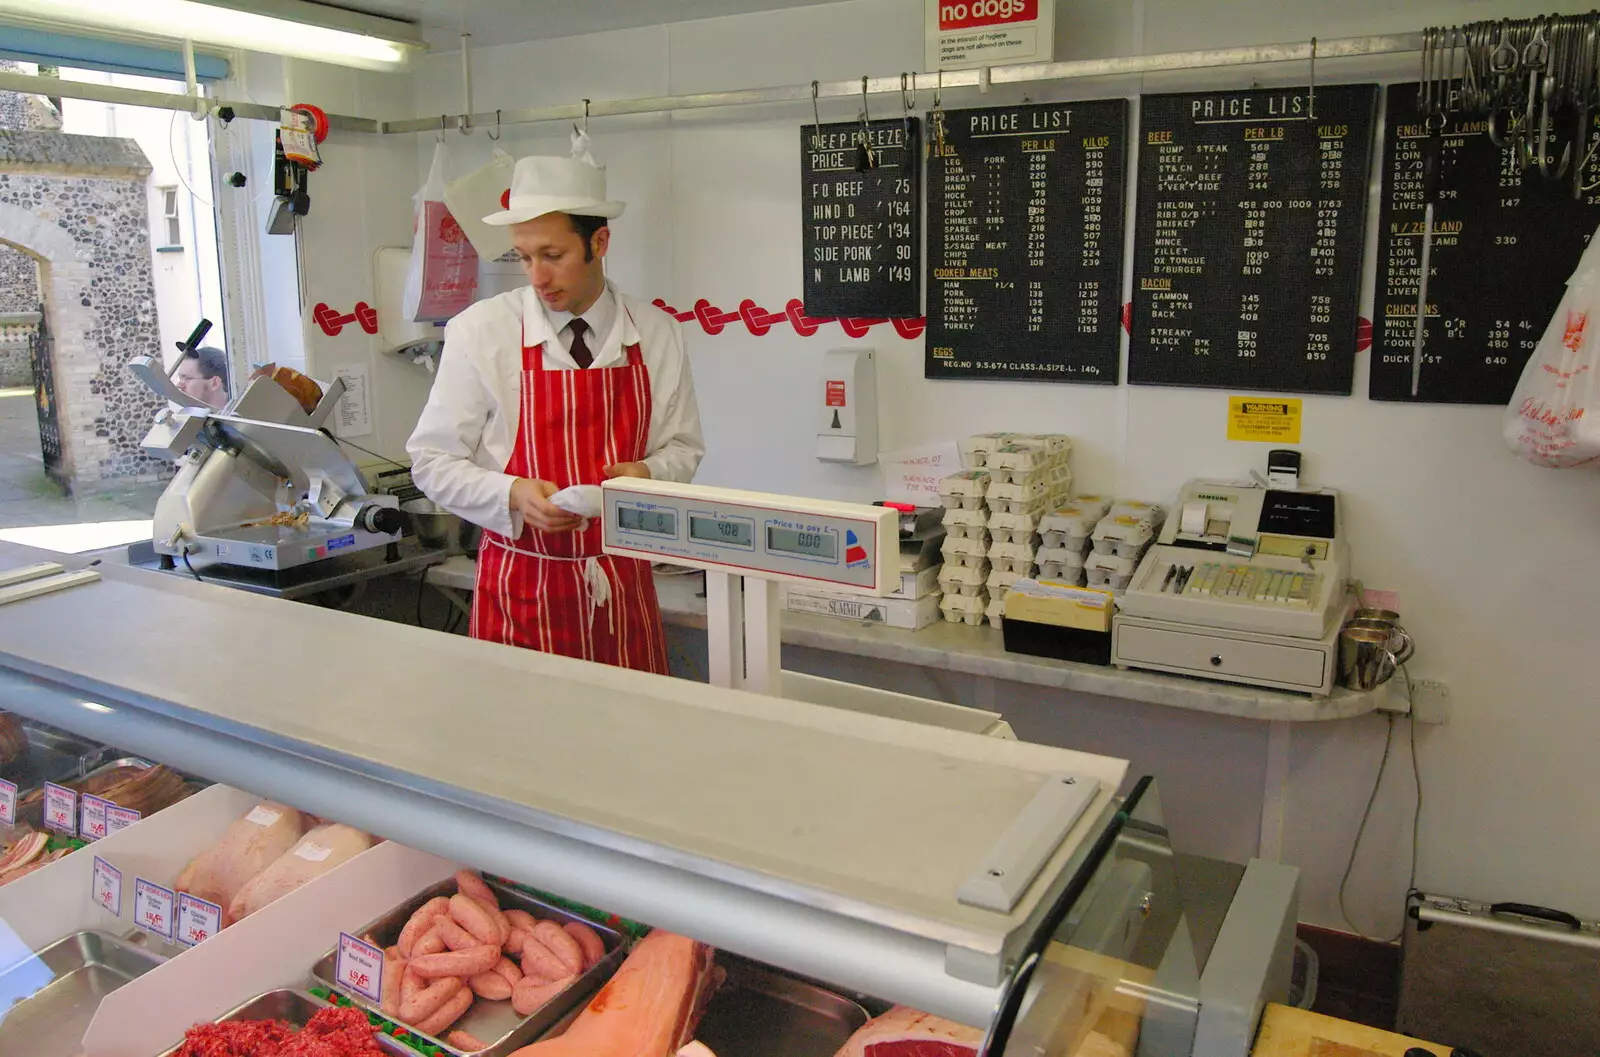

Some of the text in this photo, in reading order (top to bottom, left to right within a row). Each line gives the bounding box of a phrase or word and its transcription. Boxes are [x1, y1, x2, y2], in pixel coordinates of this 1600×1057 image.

[941, 0, 1025, 22] no dogs
[940, 54, 966, 62] premises
[1192, 98, 1252, 117] PRICE
[970, 110, 1072, 132] PRICE LIST
[1455, 121, 1490, 133] LAMB
[1148, 125, 1348, 142] BEEF PER LB KILOS
[812, 133, 846, 149] DEEP
[1022, 136, 1110, 150] PER LB KILOS
[1160, 144, 1228, 154] RUMP STEAK
[1396, 142, 1417, 150] LEG
[812, 152, 844, 168] PRICE
[1160, 155, 1183, 163] BEEF
[1396, 152, 1420, 160] LOIN
[944, 158, 960, 166] LEG
[984, 156, 1006, 164] PORK
[944, 172, 1046, 182] BREAST 220
[1248, 172, 1268, 180] 297
[1249, 182, 1268, 190] 344
[1500, 178, 1521, 186] 235
[836, 180, 910, 197] BEEF 75
[944, 200, 974, 208] FILLET
[1158, 201, 1194, 209] SIRLOIN
[1501, 198, 1520, 207] 147
[813, 204, 840, 220] HIND
[944, 208, 965, 216] CROP
[1248, 210, 1266, 218] 308
[1318, 210, 1338, 218] 679
[986, 216, 1004, 224] RIBS
[1156, 220, 1196, 228] BRISKET
[814, 226, 836, 240] TOP
[842, 224, 874, 240] PIECE
[944, 234, 980, 242] SAUSAGE
[1084, 232, 1100, 240] 507
[1390, 236, 1516, 246] LEG 330
[944, 242, 976, 250] S/SAGE
[1155, 238, 1182, 246] MINCE
[814, 245, 910, 262] SIDE PORK 90
[1082, 250, 1100, 258] 524
[1154, 248, 1188, 256] FILLET
[1390, 248, 1414, 256] LOIN
[814, 269, 822, 282] N
[840, 268, 870, 282] LAMB
[934, 268, 998, 278] COOKED MEATS
[1142, 278, 1171, 288] BACON
[1388, 288, 1418, 296] LIVER
[1170, 302, 1193, 310] STKS
[1386, 304, 1438, 314] CHICKNS
[1152, 310, 1175, 318] BACK
[1028, 324, 1040, 332] 131
[1150, 328, 1328, 342] STREAKY 705
[1488, 330, 1510, 338] 399
[1238, 340, 1256, 348] 570
[1488, 340, 1508, 348] 480
[933, 348, 954, 356] EGGS
[1383, 355, 1507, 364] DUCK 640
[1246, 403, 1284, 412] WARNING
[1197, 494, 1228, 502] SAMSUNG
[636, 502, 657, 510] Weight
[774, 520, 792, 528] Price
[796, 522, 804, 530] to
[807, 524, 820, 532] pay
[828, 600, 862, 617] SUMMIT
